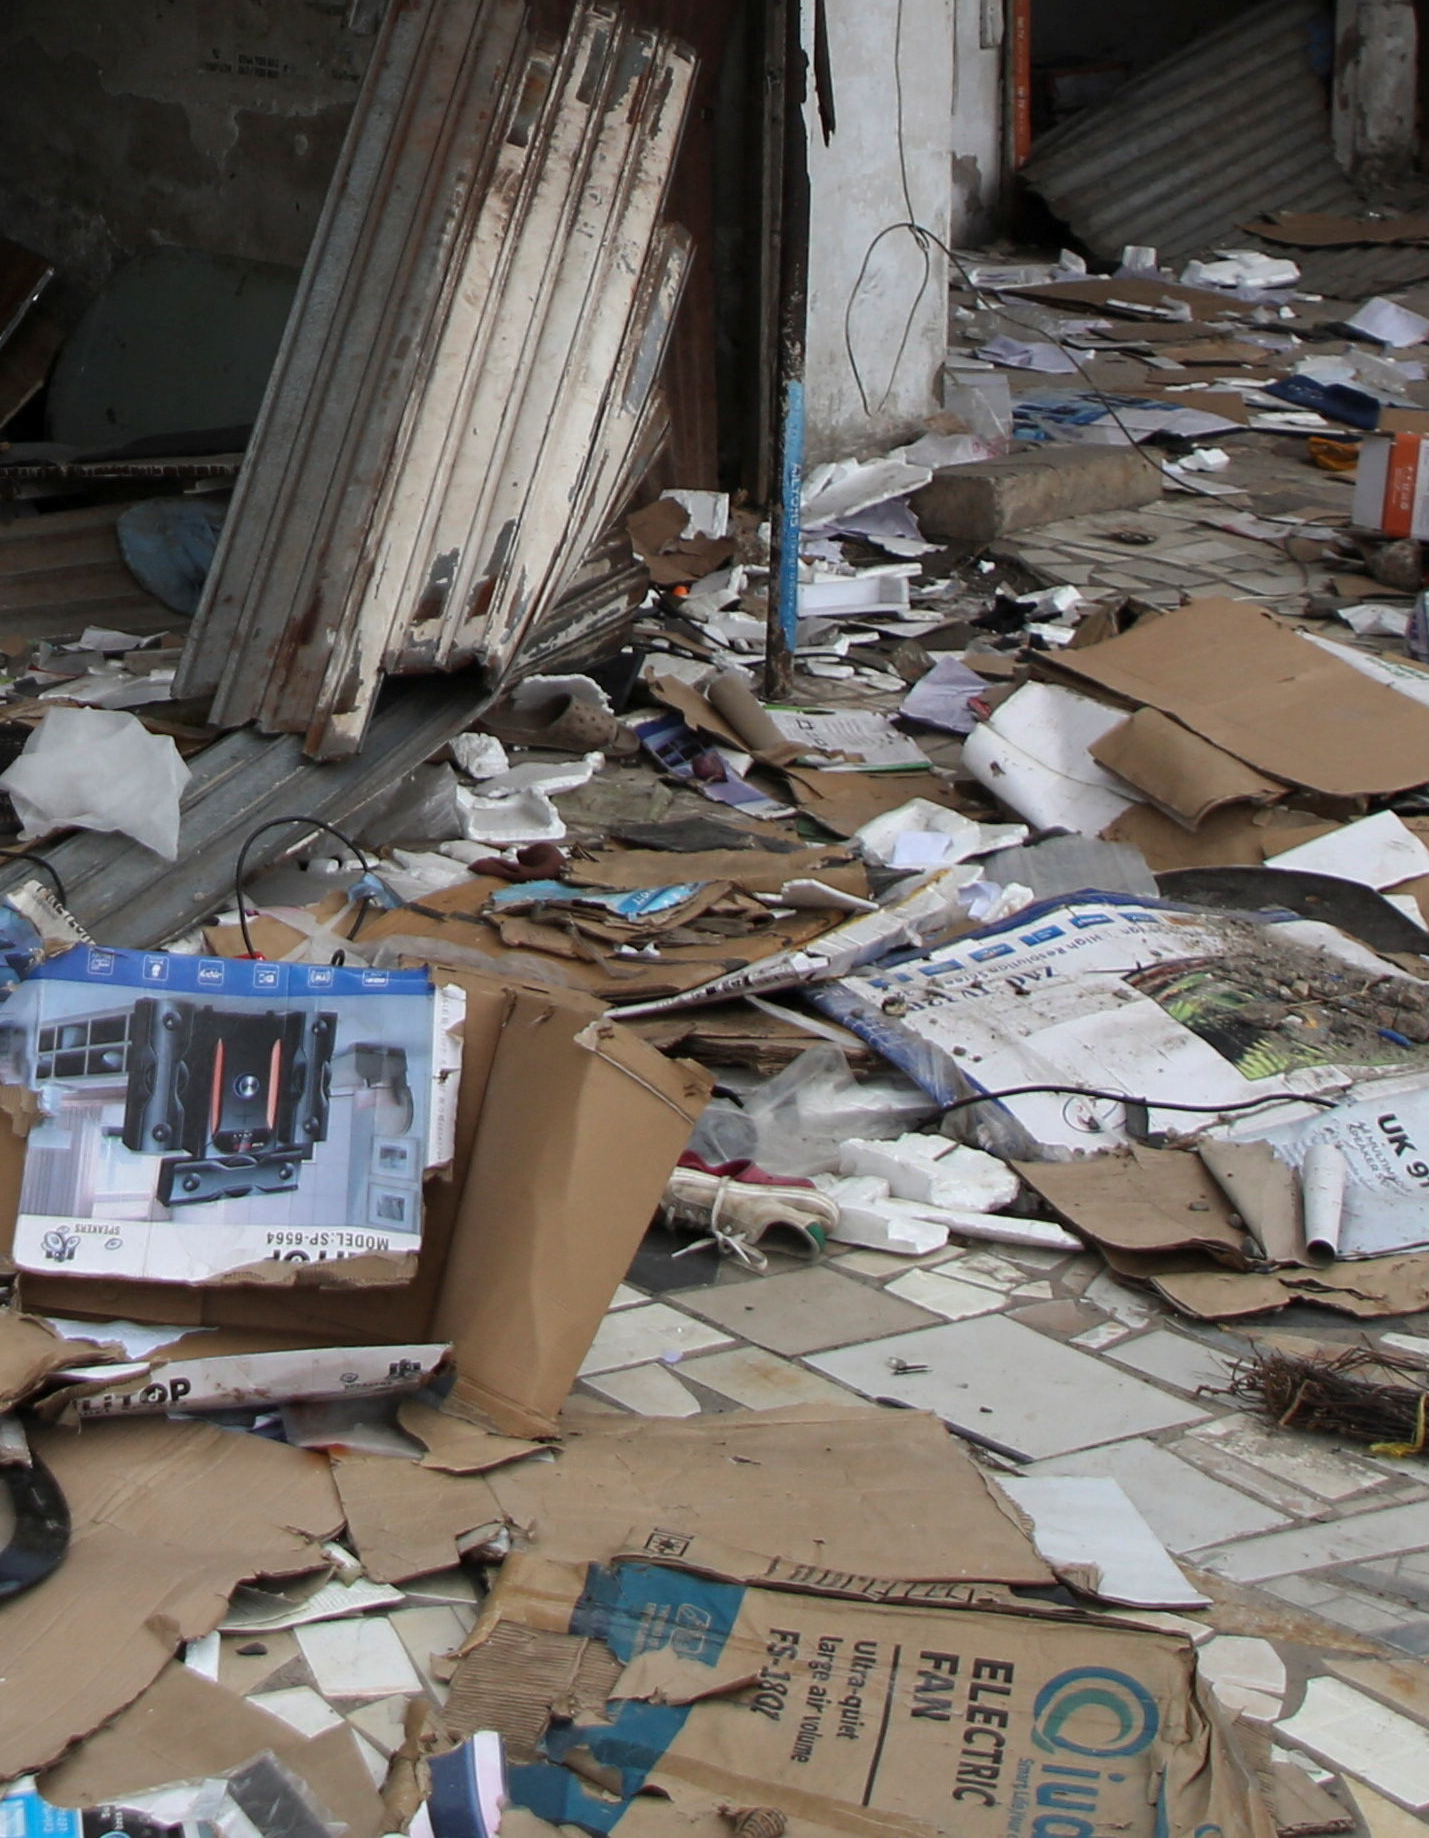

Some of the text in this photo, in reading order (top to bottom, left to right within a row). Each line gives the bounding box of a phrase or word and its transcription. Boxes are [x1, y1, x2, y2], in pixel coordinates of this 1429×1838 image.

[1377, 1113, 1417, 1157] UK
[75, 1222, 122, 1237] SPEAKERS
[790, 1634, 844, 1764] large air volume
[837, 1639, 878, 1741] Ultra-quiet
[911, 1649, 959, 1721] FAN
[953, 1656, 1015, 1808] ELECTRIC
